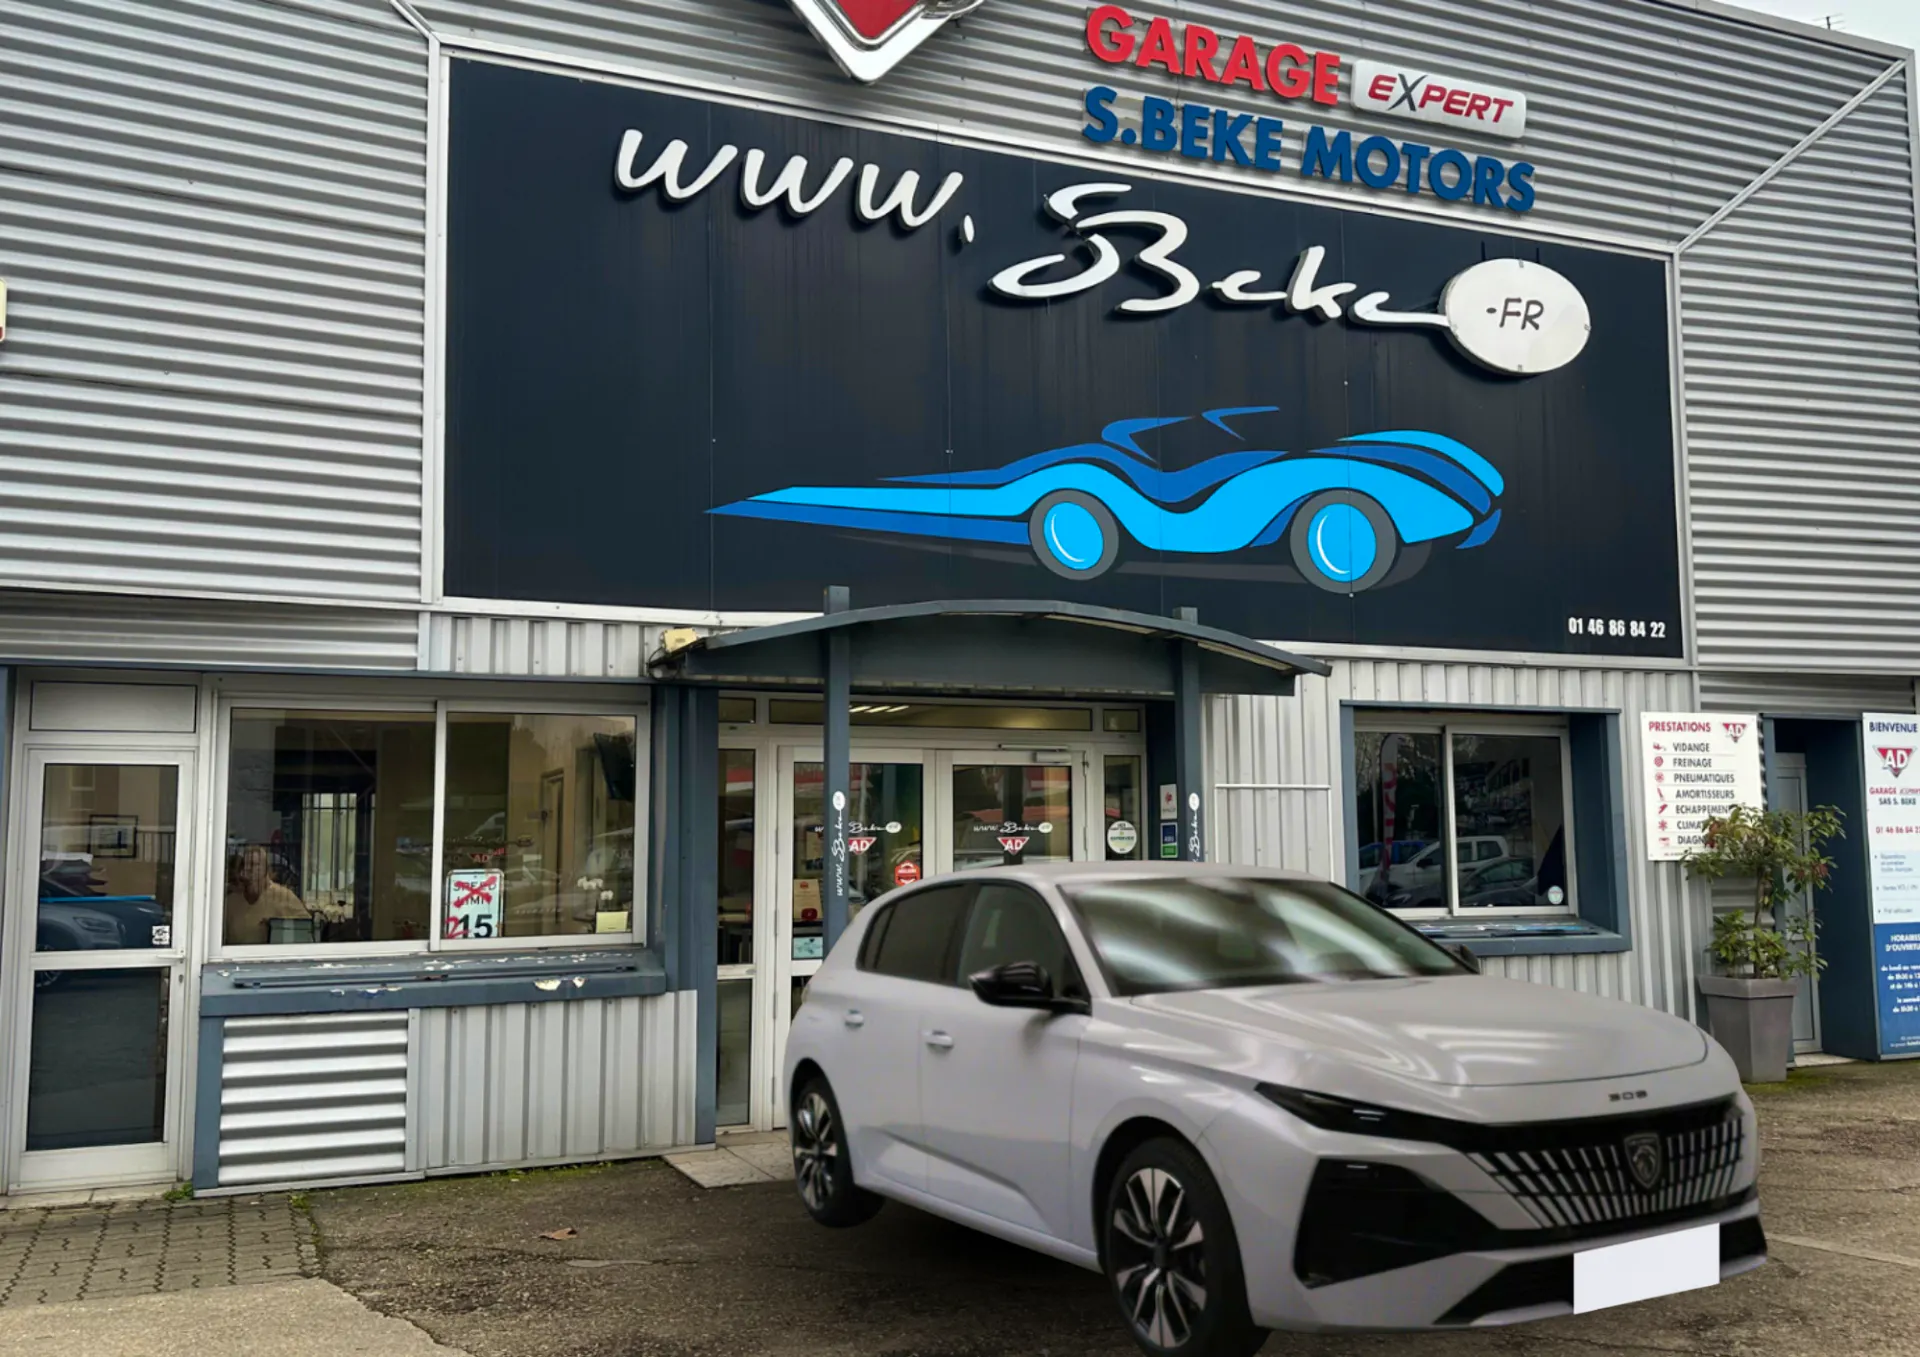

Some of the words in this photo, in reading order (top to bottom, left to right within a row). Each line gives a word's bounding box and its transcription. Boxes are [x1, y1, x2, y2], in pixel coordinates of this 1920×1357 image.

[1086, 6, 1340, 106] GARAGE
[1368, 73, 1514, 123] EXPERT
[1083, 86, 1284, 172] S.BEKE
[1302, 125, 1536, 212] MOTORS
[1568, 617, 1583, 634] 01
[1587, 619, 1604, 635] 46
[1609, 620, 1625, 636] 86
[1630, 621, 1646, 637] 84
[1650, 622, 1666, 638] 22
[1648, 720, 1711, 733] PRESTATIONS
[1869, 721, 1918, 733] BIENVENUE
[1672, 742, 1711, 752] VIDANGE
[1673, 758, 1712, 768] FREINAGE
[1884, 749, 1908, 769] AD
[1674, 773, 1735, 784] PNEUMATIQUES
[1675, 789, 1735, 799] AMORTISSEURS
